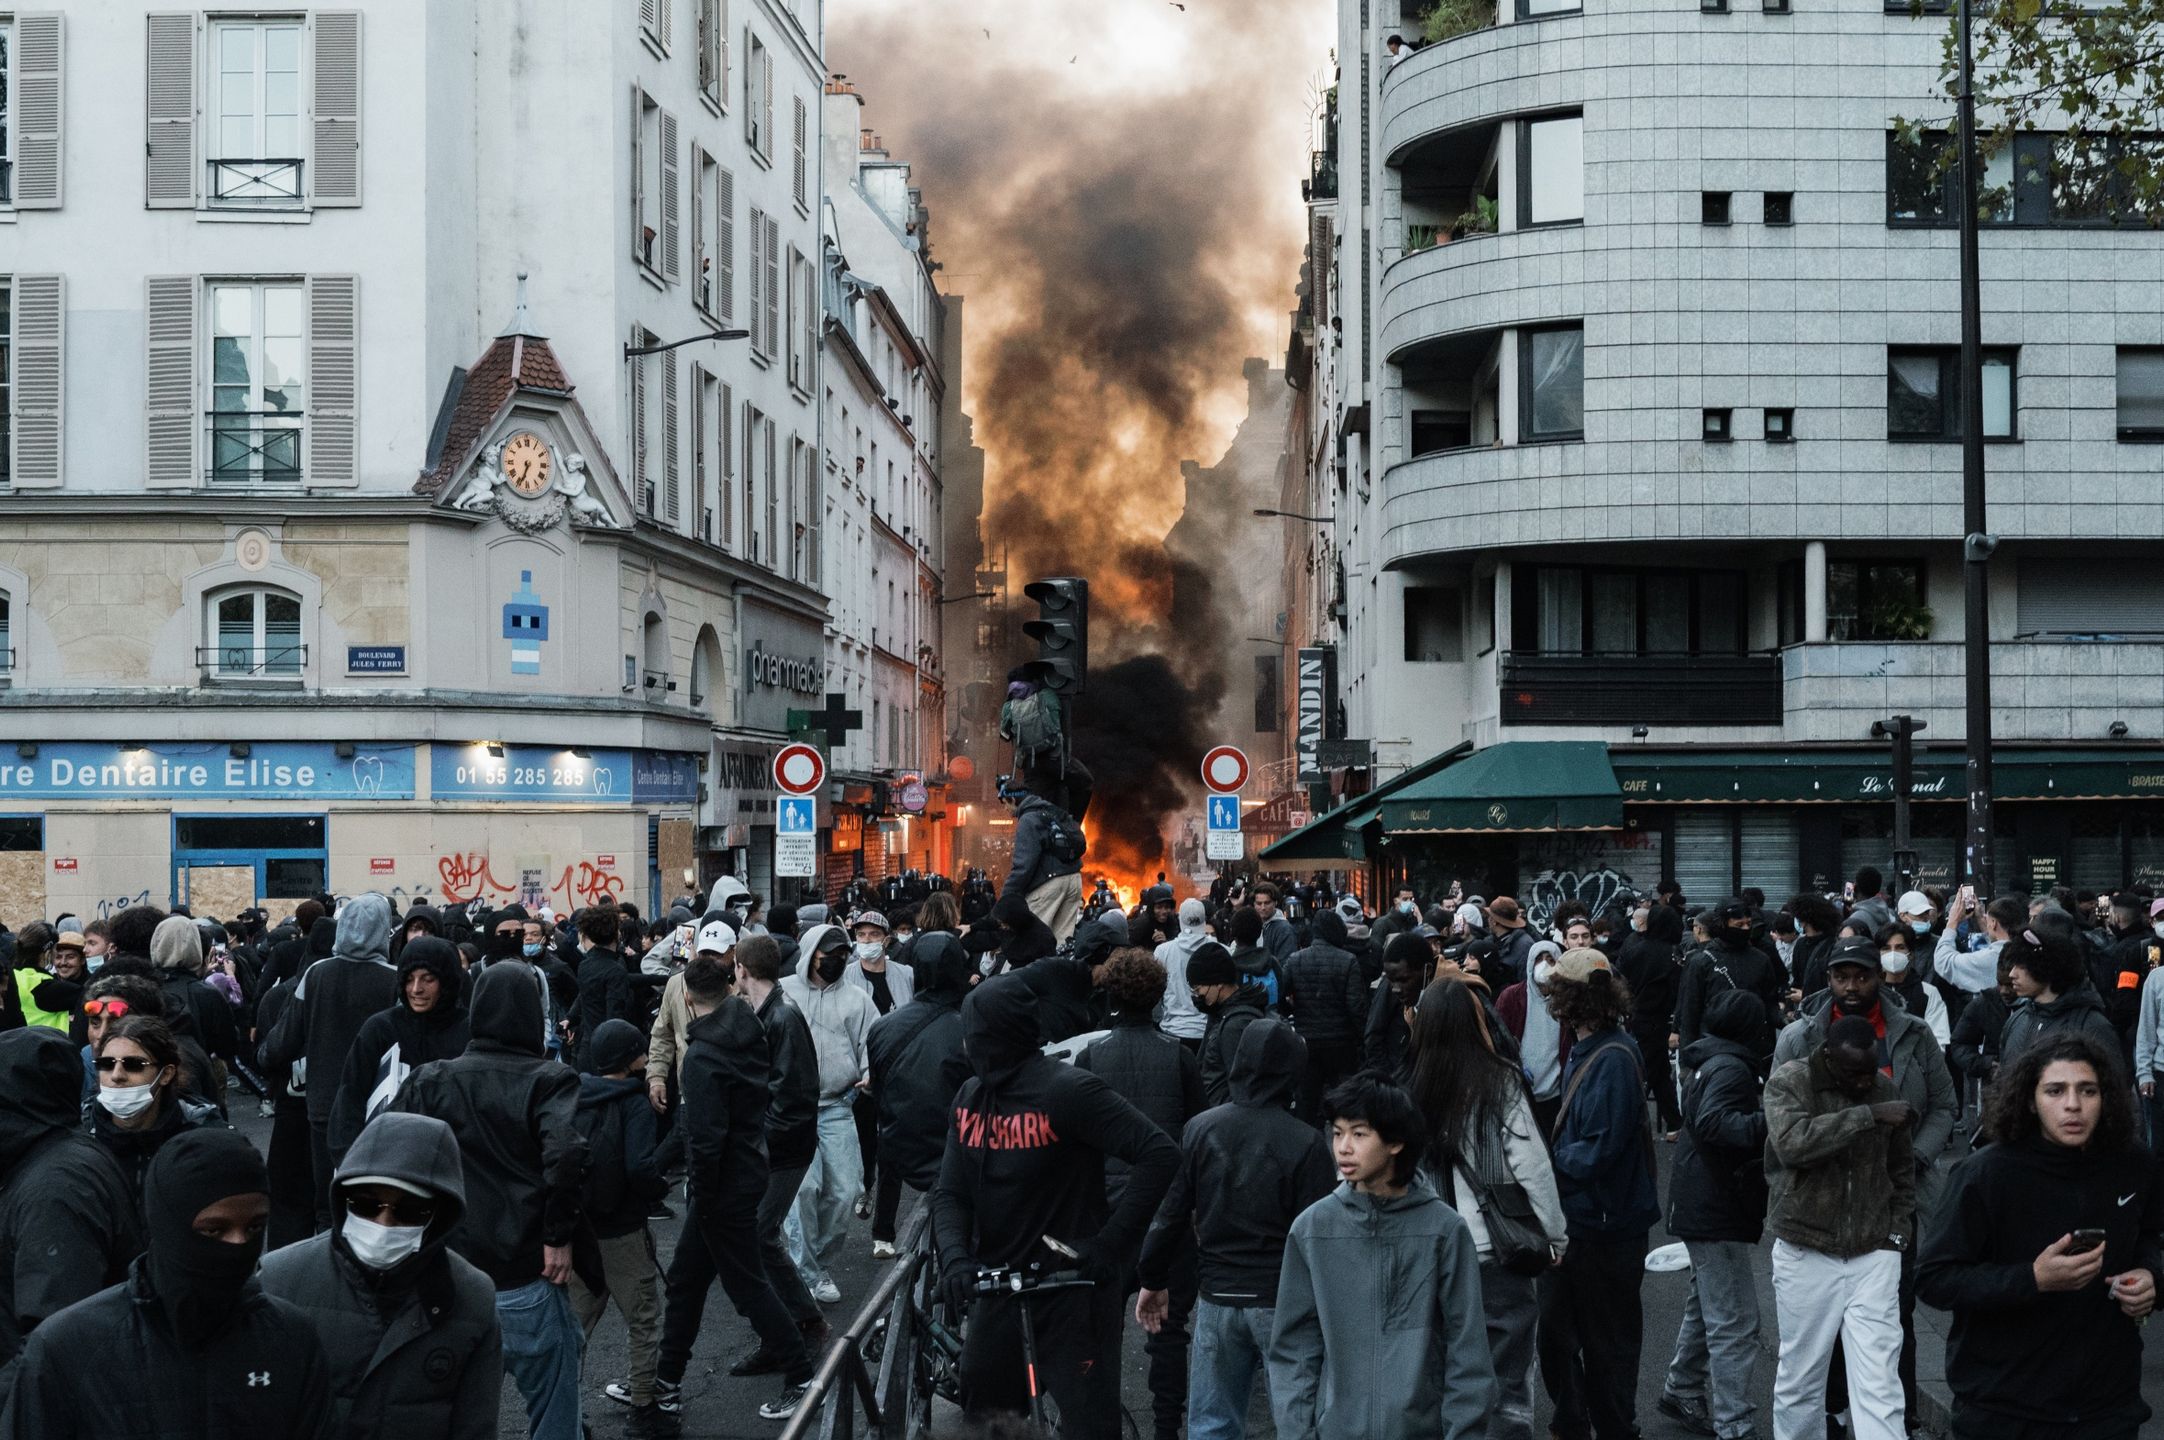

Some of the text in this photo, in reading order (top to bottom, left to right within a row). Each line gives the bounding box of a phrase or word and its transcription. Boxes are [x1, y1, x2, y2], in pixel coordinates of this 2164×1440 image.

[753, 641, 824, 695] pharmacie
[1300, 658, 1321, 774] MANDIN
[51, 759, 208, 787] Dentaire
[225, 759, 316, 787] Elise
[456, 767, 584, 786] 01 55 285 285
[1858, 776, 1946, 793] Le nal
[1623, 780, 1648, 792] CAFE
